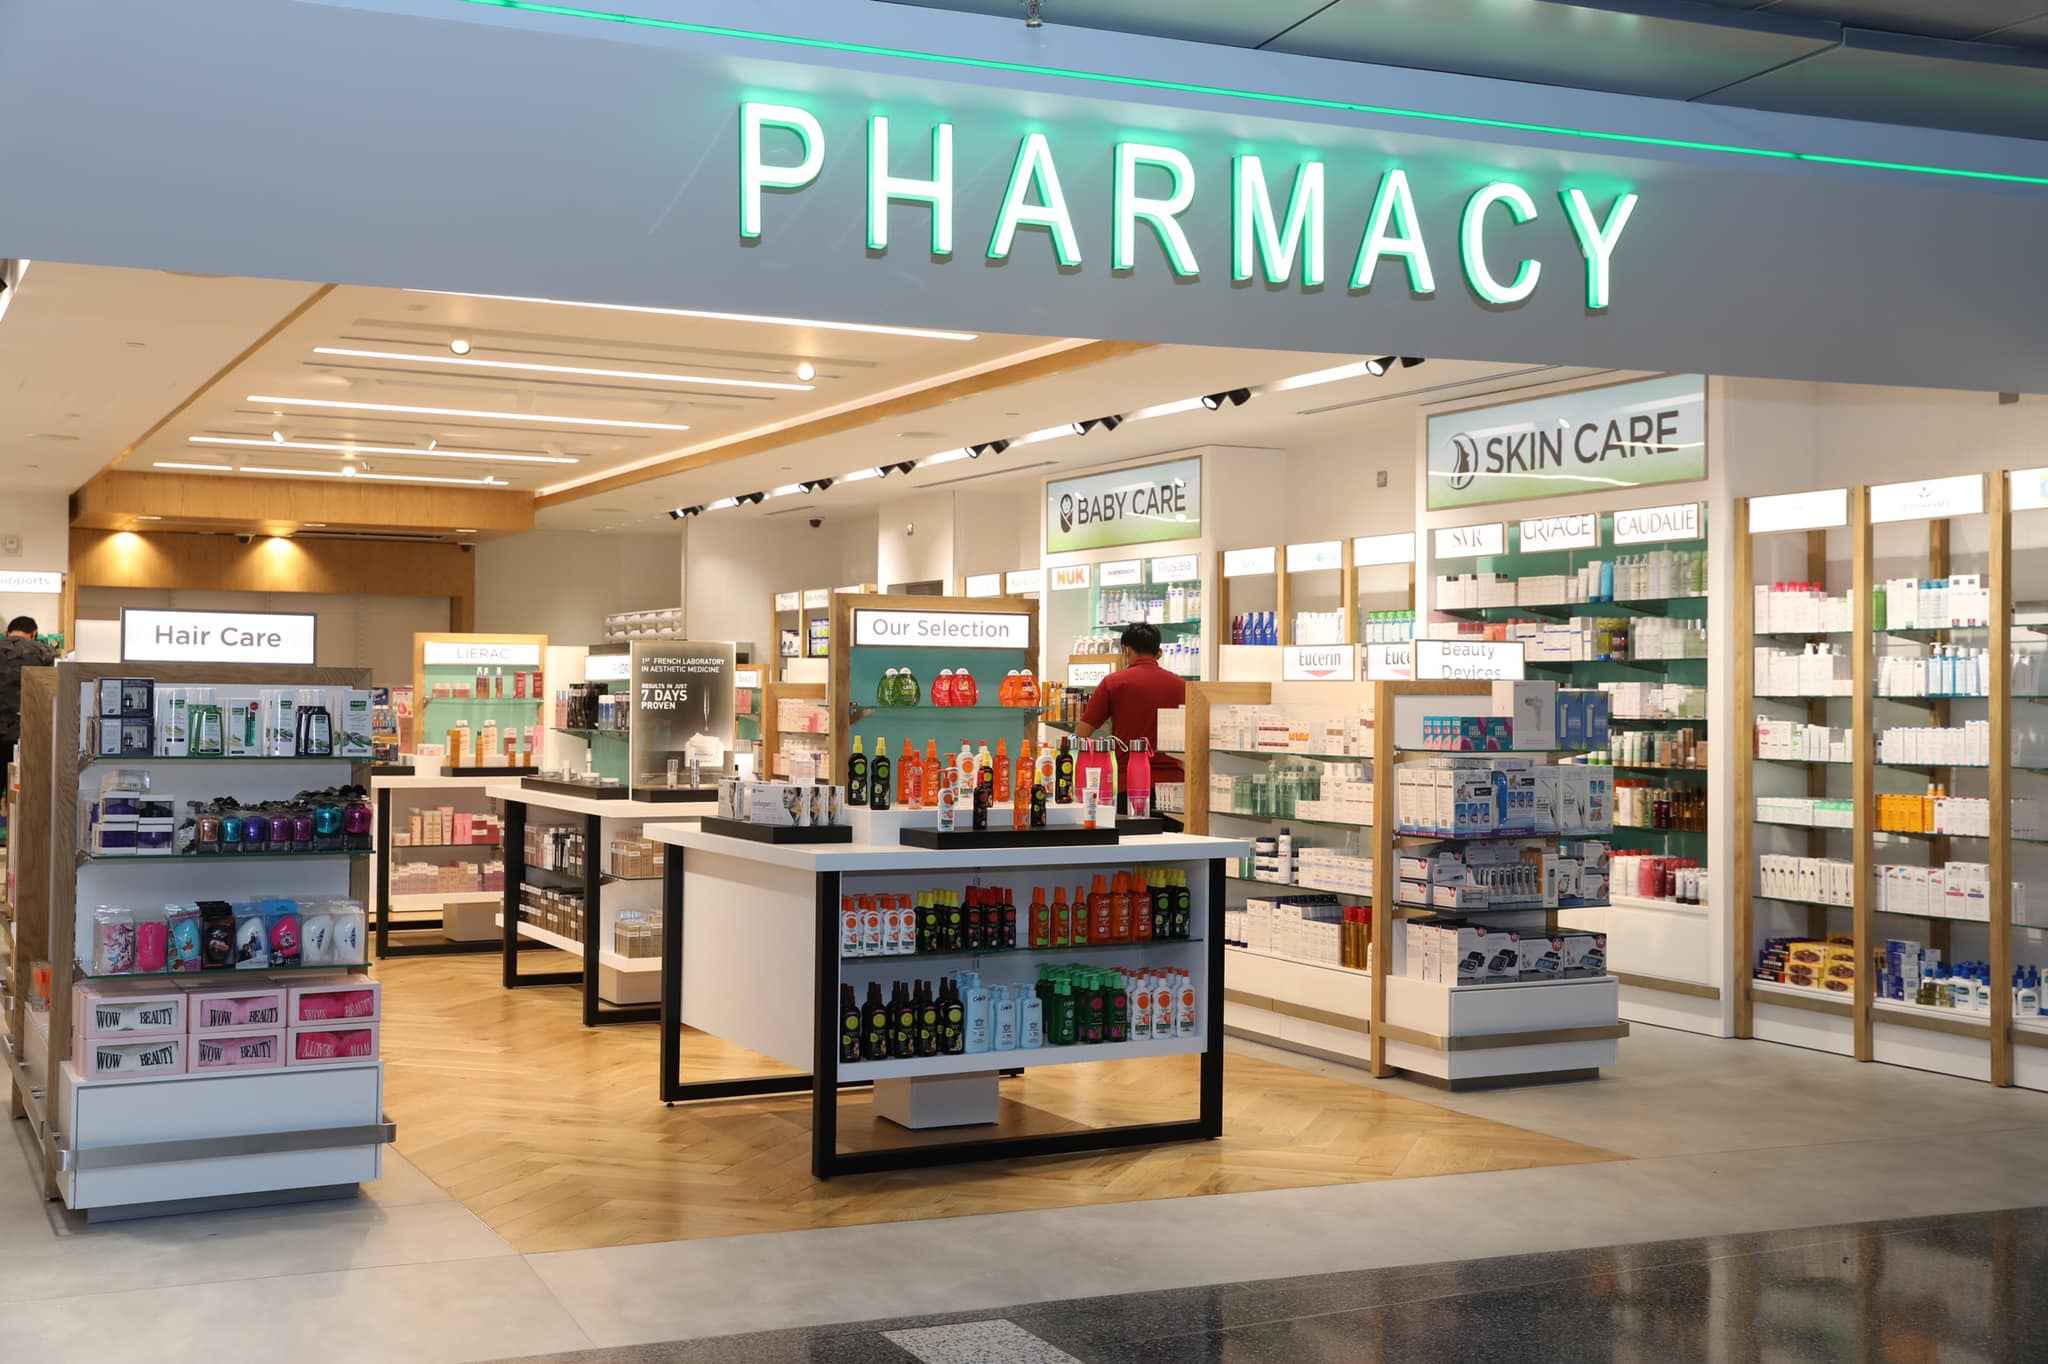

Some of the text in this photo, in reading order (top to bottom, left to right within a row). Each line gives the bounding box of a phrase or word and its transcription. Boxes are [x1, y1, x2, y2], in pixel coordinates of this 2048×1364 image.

[739, 101, 1640, 310] PHARMACY
[1486, 411, 1680, 473] SKIN CARE
[1078, 483, 1186, 525] BABY CARE
[1616, 509, 1696, 536] CAUDALIE
[1057, 569, 1085, 584] NUK
[155, 624, 282, 648] Hair Care
[872, 618, 1010, 640] Our Selection
[456, 647, 511, 660] LIERAC
[653, 657, 681, 665] FRENCH
[1299, 648, 1342, 667] Eucerin
[1441, 643, 1495, 662] Beauty
[641, 689, 688, 701] 7 DAYS
[641, 701, 676, 710] PROVEN
[96, 1007, 172, 1029] WOW BEAUTY
[209, 1006, 279, 1026] WOW BEAUTY
[96, 1046, 175, 1070] WOW BEAUTY
[200, 1040, 272, 1061] WOW BEAUTY
